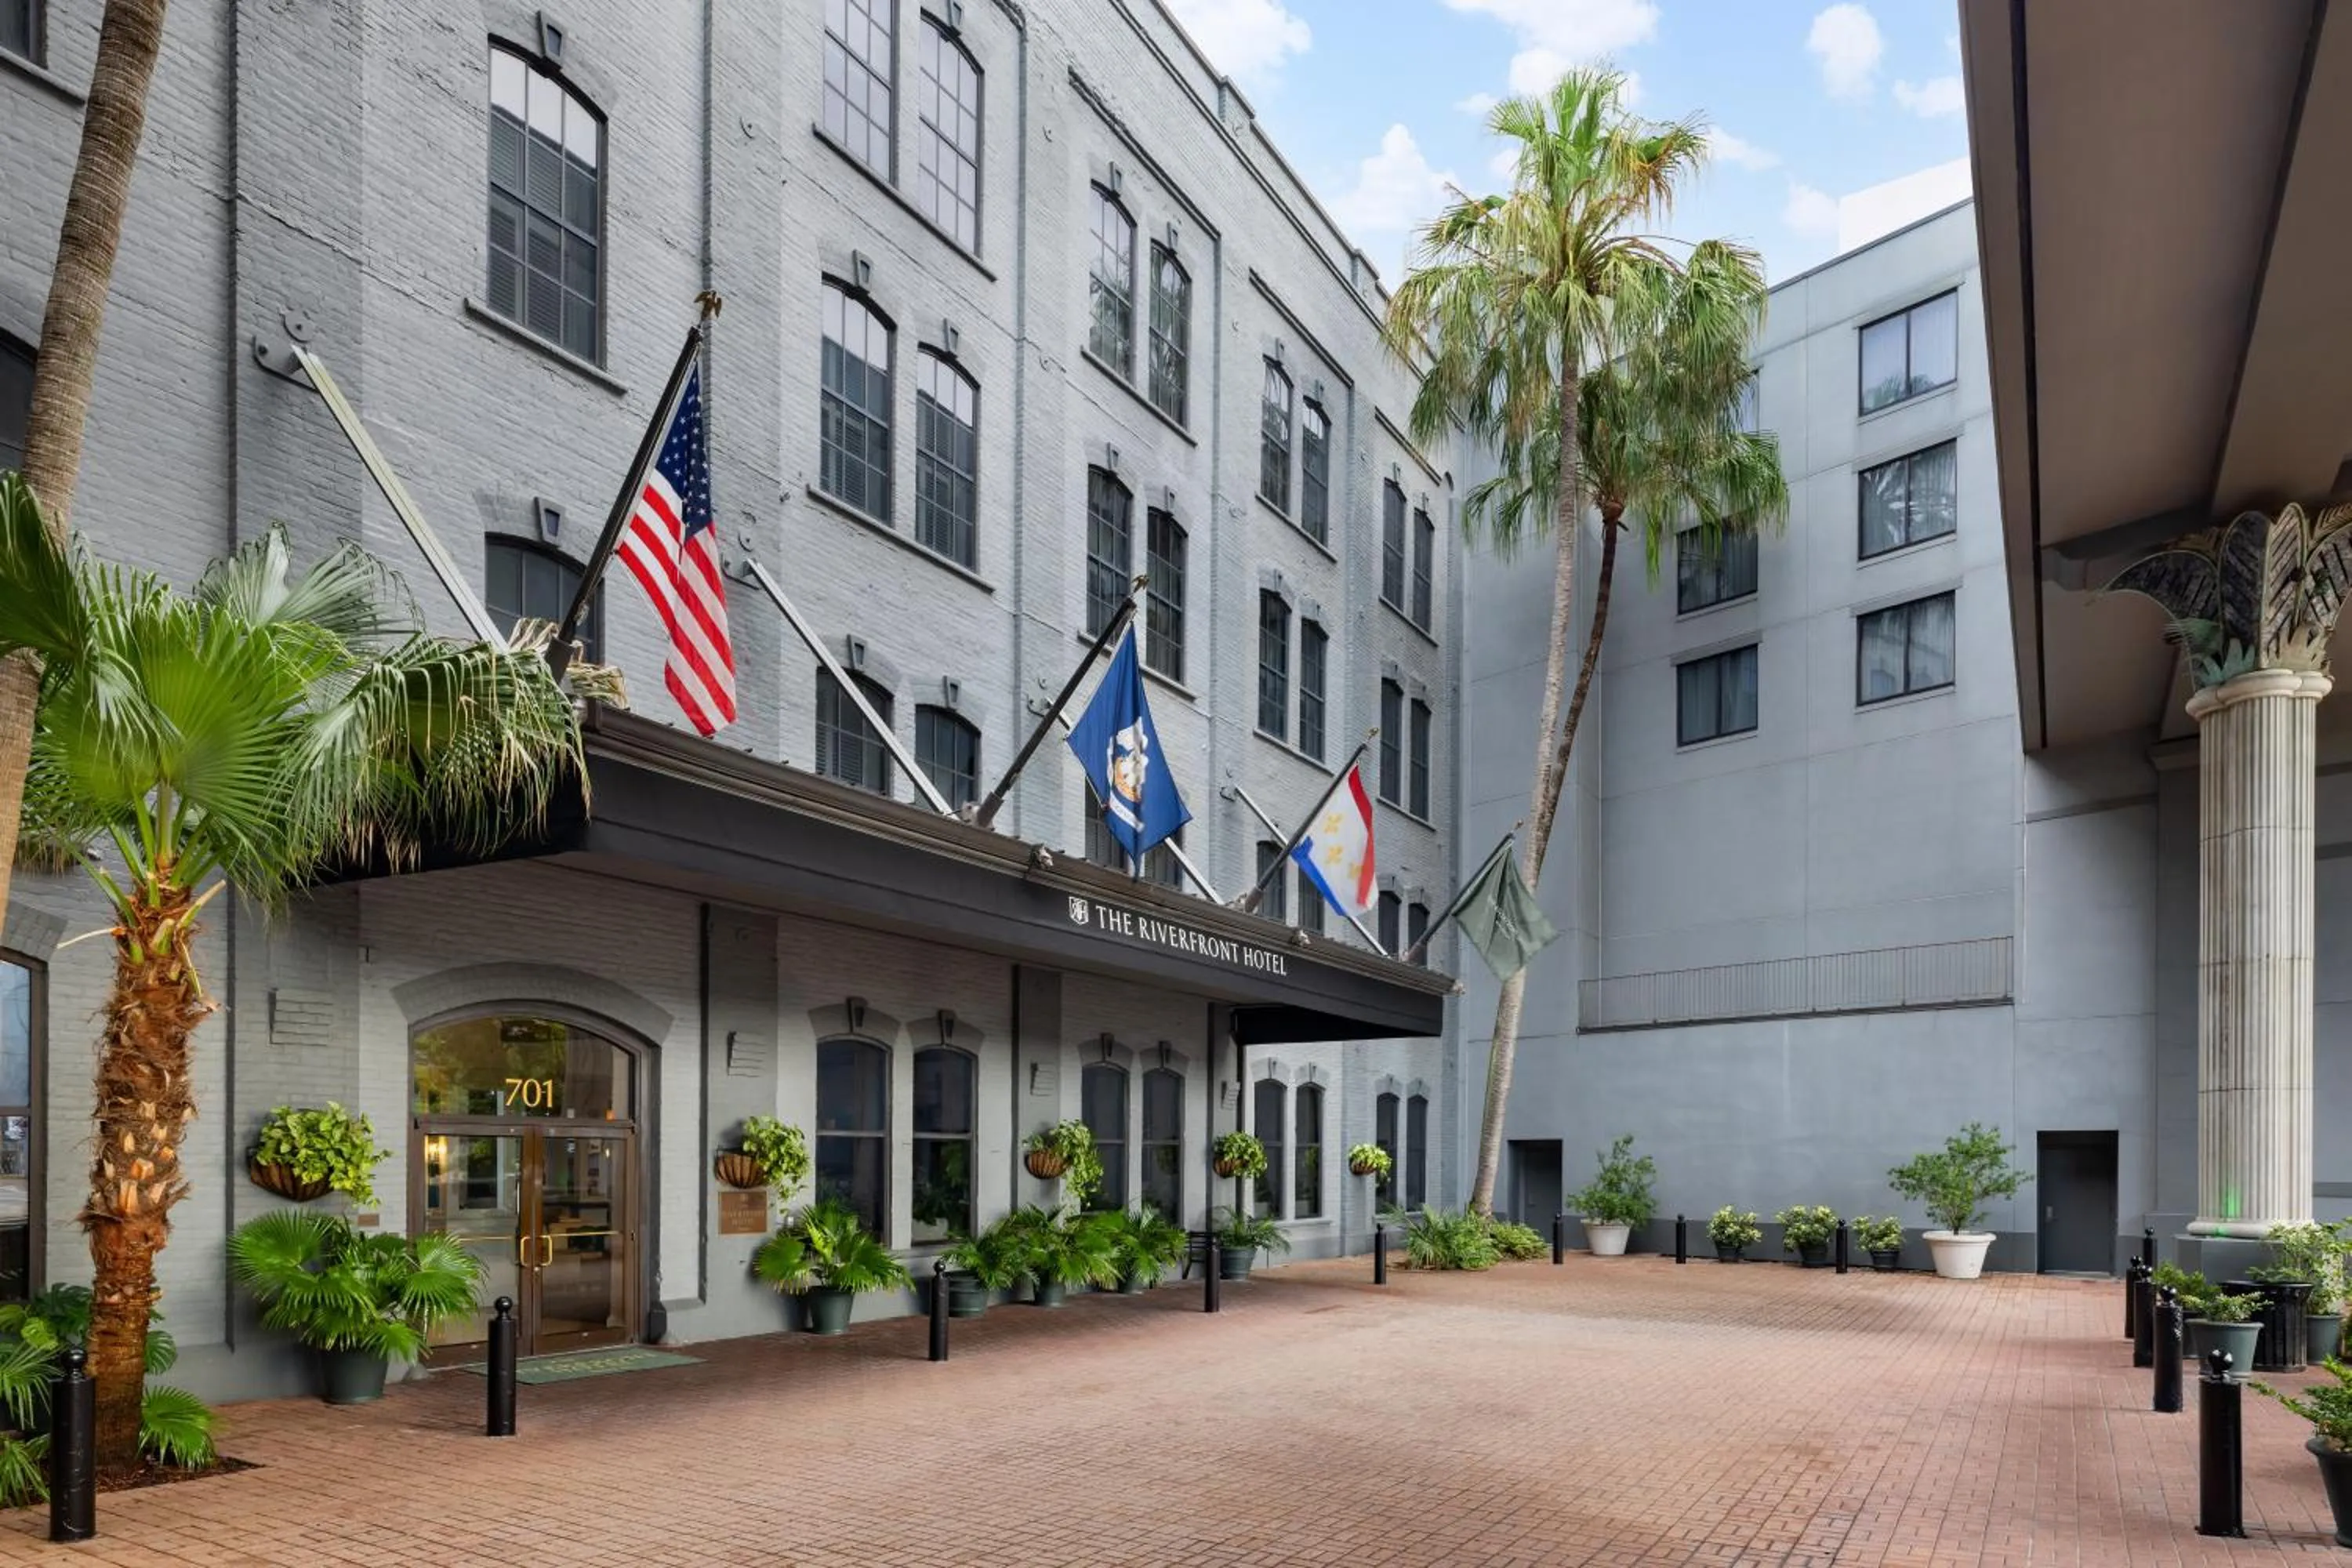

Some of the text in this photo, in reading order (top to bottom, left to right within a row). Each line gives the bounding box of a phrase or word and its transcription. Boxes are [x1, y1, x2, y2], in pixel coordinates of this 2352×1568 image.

[1096, 906, 1134, 935] THE
[1139, 916, 1240, 964] RIVERFRONT
[1243, 946, 1287, 976] HOTEL
[505, 1078, 553, 1108] 701
